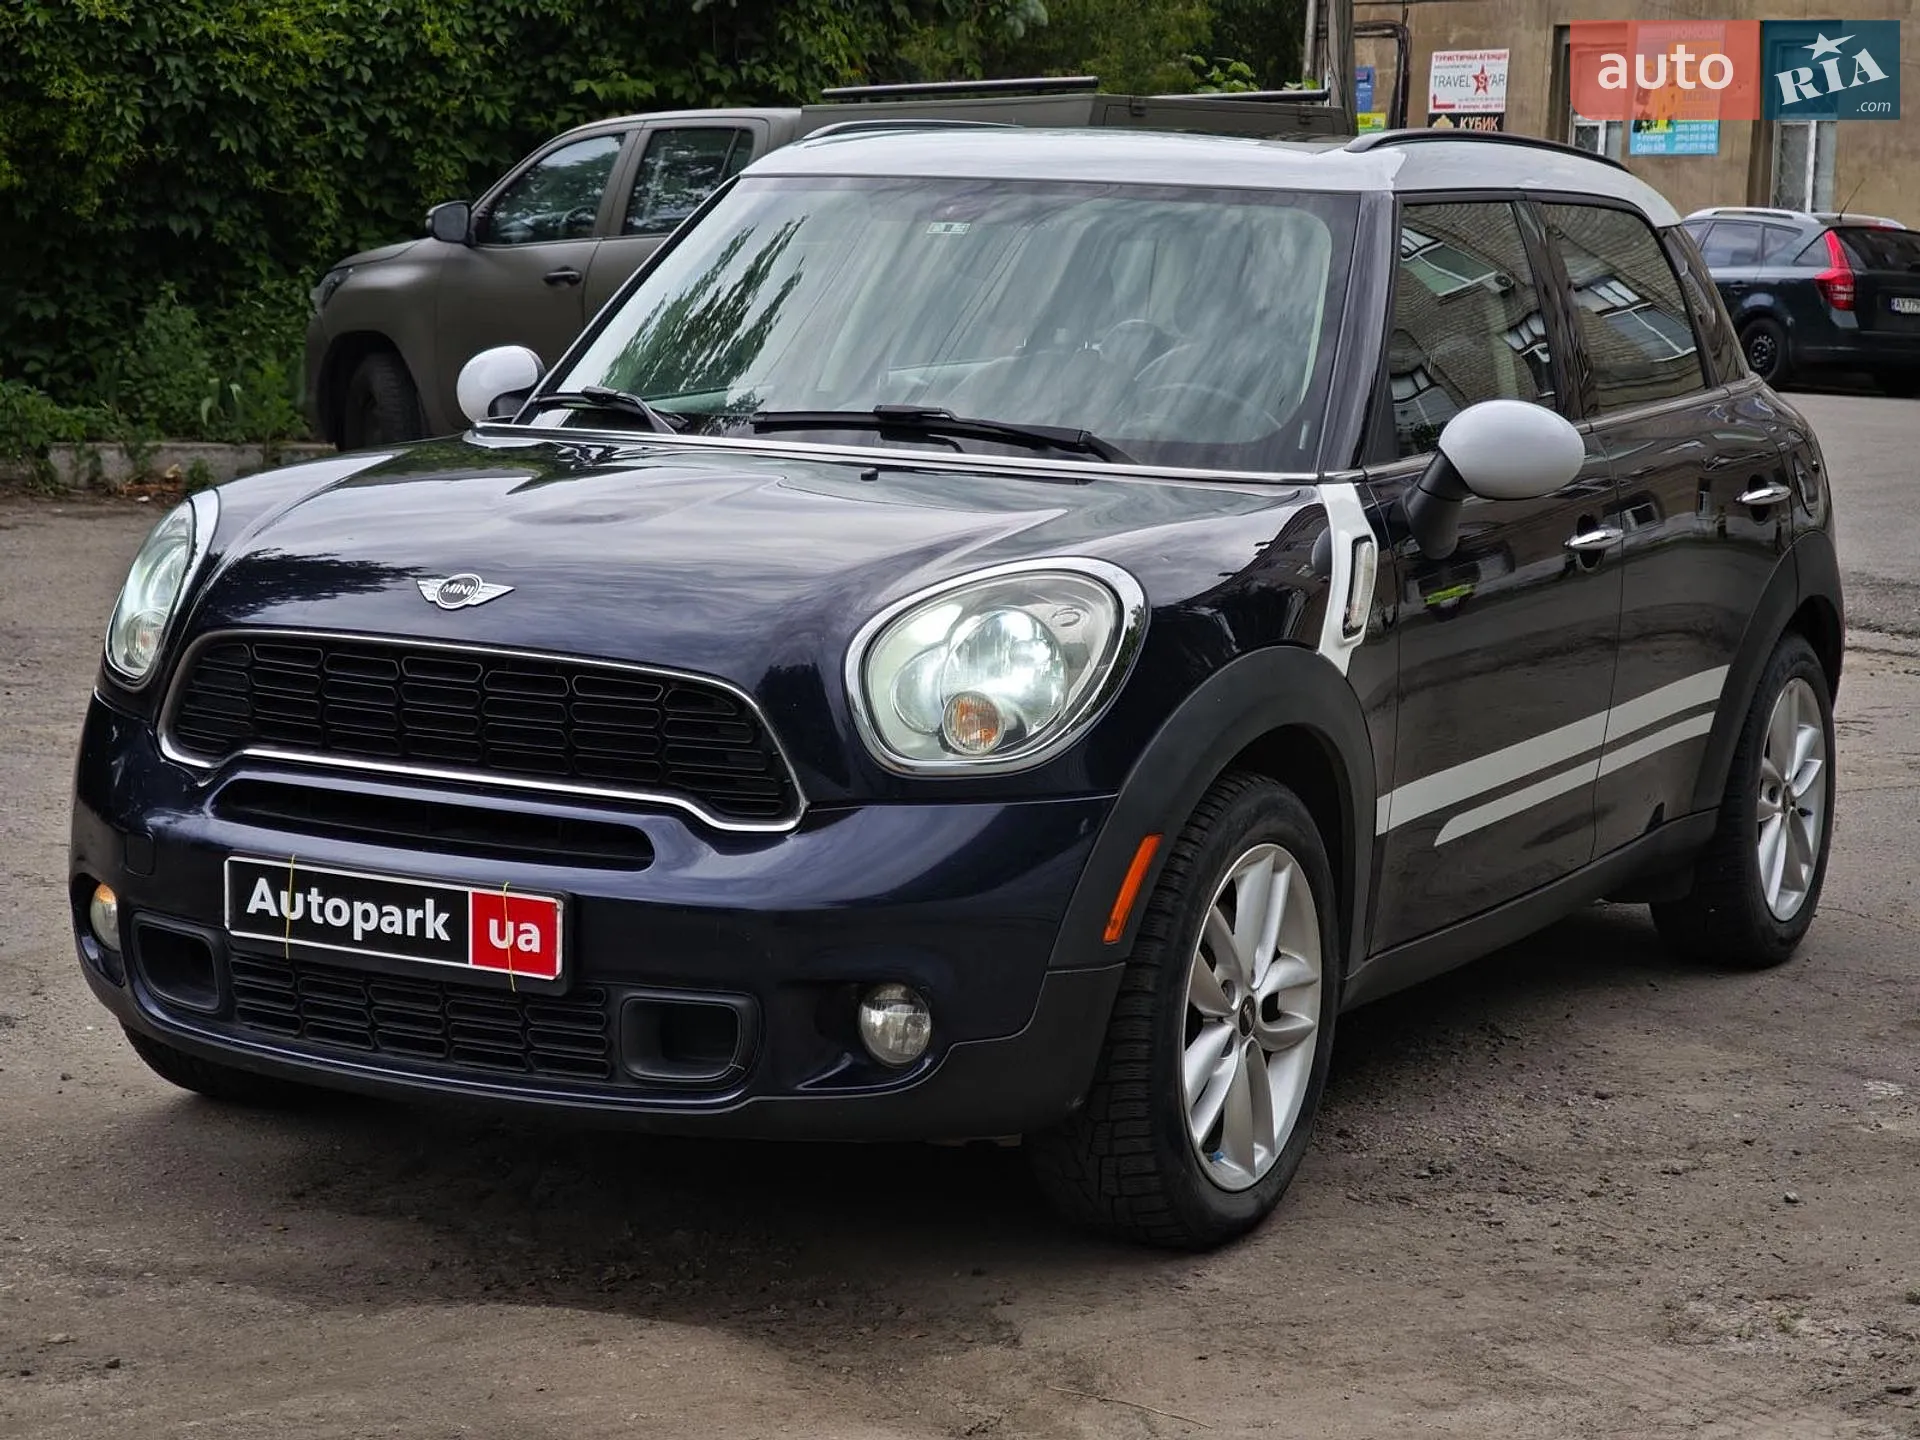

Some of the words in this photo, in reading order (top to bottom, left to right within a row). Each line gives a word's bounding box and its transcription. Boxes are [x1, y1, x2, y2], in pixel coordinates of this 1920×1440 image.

[1433, 74, 1471, 88] TRAVEL
[1459, 116, 1499, 132] КУБИК
[441, 583, 475, 596] MINI
[246, 877, 451, 941] Autopark
[488, 918, 541, 953] ua
